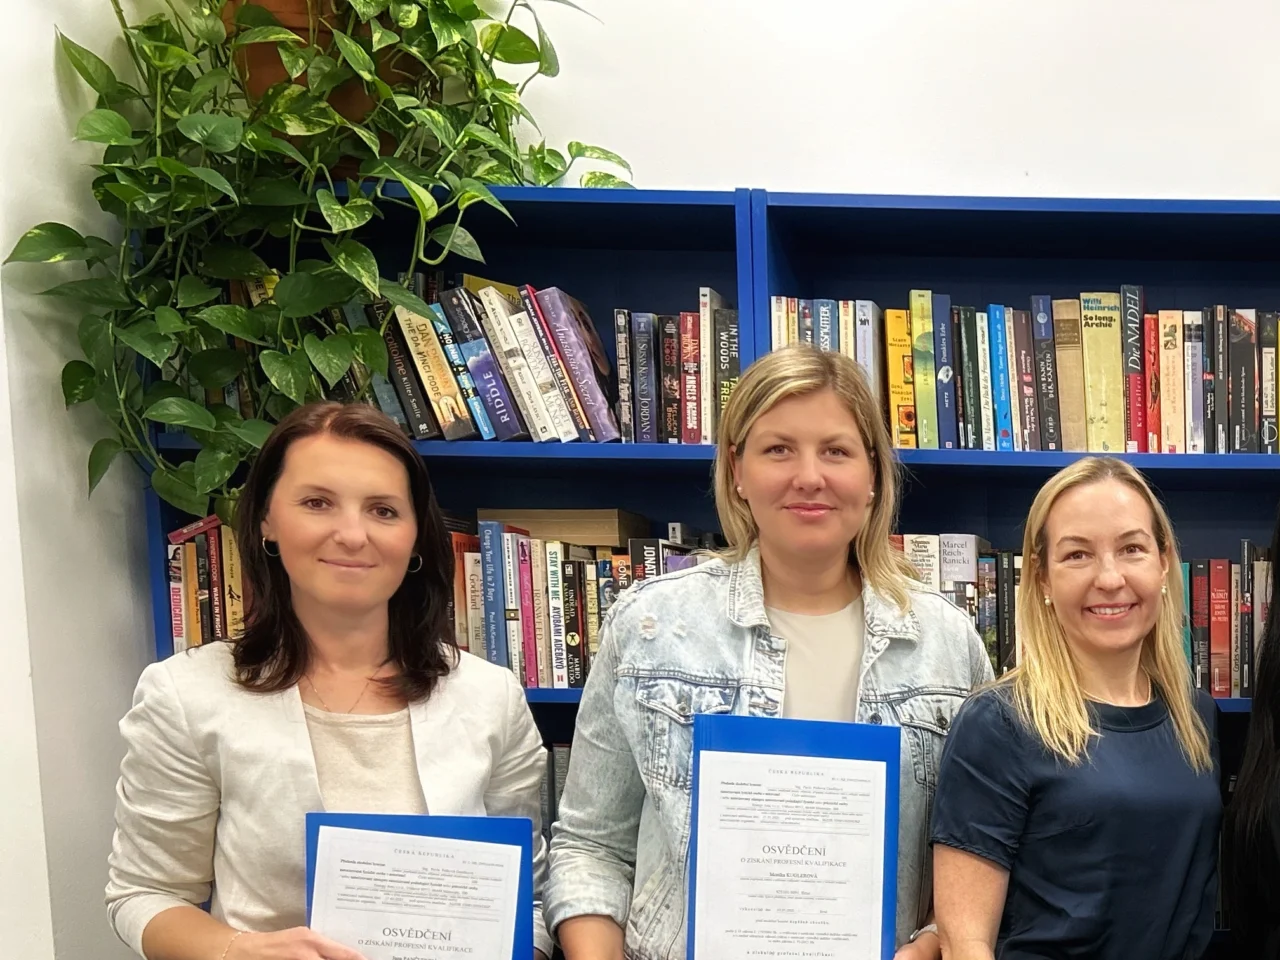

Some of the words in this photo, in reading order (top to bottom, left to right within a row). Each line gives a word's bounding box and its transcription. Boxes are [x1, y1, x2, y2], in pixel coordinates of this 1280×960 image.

[1083, 304, 1120, 312] Heinrich
[1094, 315, 1117, 323] long,
[1126, 290, 1141, 344] NADEL
[416, 323, 434, 347] DAN
[729, 324, 738, 336] IN
[383, 323, 408, 377] Scottoline
[402, 317, 416, 337] THE
[410, 336, 421, 348] DA
[416, 351, 431, 374] VINCI
[425, 375, 442, 398] CODE
[441, 333, 462, 365] HORNBY
[681, 333, 692, 360] BROWN
[691, 339, 699, 356] DAN
[719, 331, 730, 370] WOODS
[729, 337, 739, 358] THE
[938, 337, 948, 363] Dunkles
[1128, 344, 1143, 371] Die
[553, 322, 582, 377] Anastasia's
[572, 377, 600, 407] Secret
[1045, 353, 1054, 382] KARTEN
[400, 376, 414, 397] Killer
[409, 397, 422, 419] Smile
[482, 370, 511, 424] RIDDLE
[685, 375, 698, 400] ANGELS
[484, 393, 495, 407] THE
[639, 396, 653, 433] JORDAN
[209, 536, 218, 564] KENNETH
[483, 529, 493, 550] Change
[942, 541, 968, 549] Marcel
[485, 551, 493, 563] Your
[548, 550, 558, 569] STAY
[942, 549, 965, 557] Reich-
[942, 557, 971, 565] Ranicki
[210, 564, 219, 582] COOK
[486, 564, 494, 574] Life
[550, 569, 559, 588] WITH
[617, 559, 628, 587] GONE
[634, 563, 643, 578] THE
[212, 586, 220, 605] WAKE
[469, 573, 481, 610] Goddard
[487, 587, 495, 602] Days
[551, 589, 560, 601] ME
[170, 586, 184, 638] DEDICATION
[567, 588, 576, 618] UNDEAD
[214, 613, 222, 638] FRIGHT
[488, 611, 497, 623] Paul
[534, 588, 544, 641] IRONWEED
[567, 653, 576, 684] ACEVEDO
[573, 657, 581, 680] MARIO
[762, 843, 827, 857] OSVĚDČENÍ
[746, 856, 773, 865] ZÍSKÁNÍ
[773, 858, 804, 866] PROFESNÍ
[804, 860, 848, 868] KVALIFIKACE
[382, 926, 453, 942] OSVĚDČENÍ
[364, 938, 394, 948] ZÍSKÁNÍ
[393, 941, 428, 950] PROFESNÍ
[427, 943, 474, 954] KVALIFIKACE
